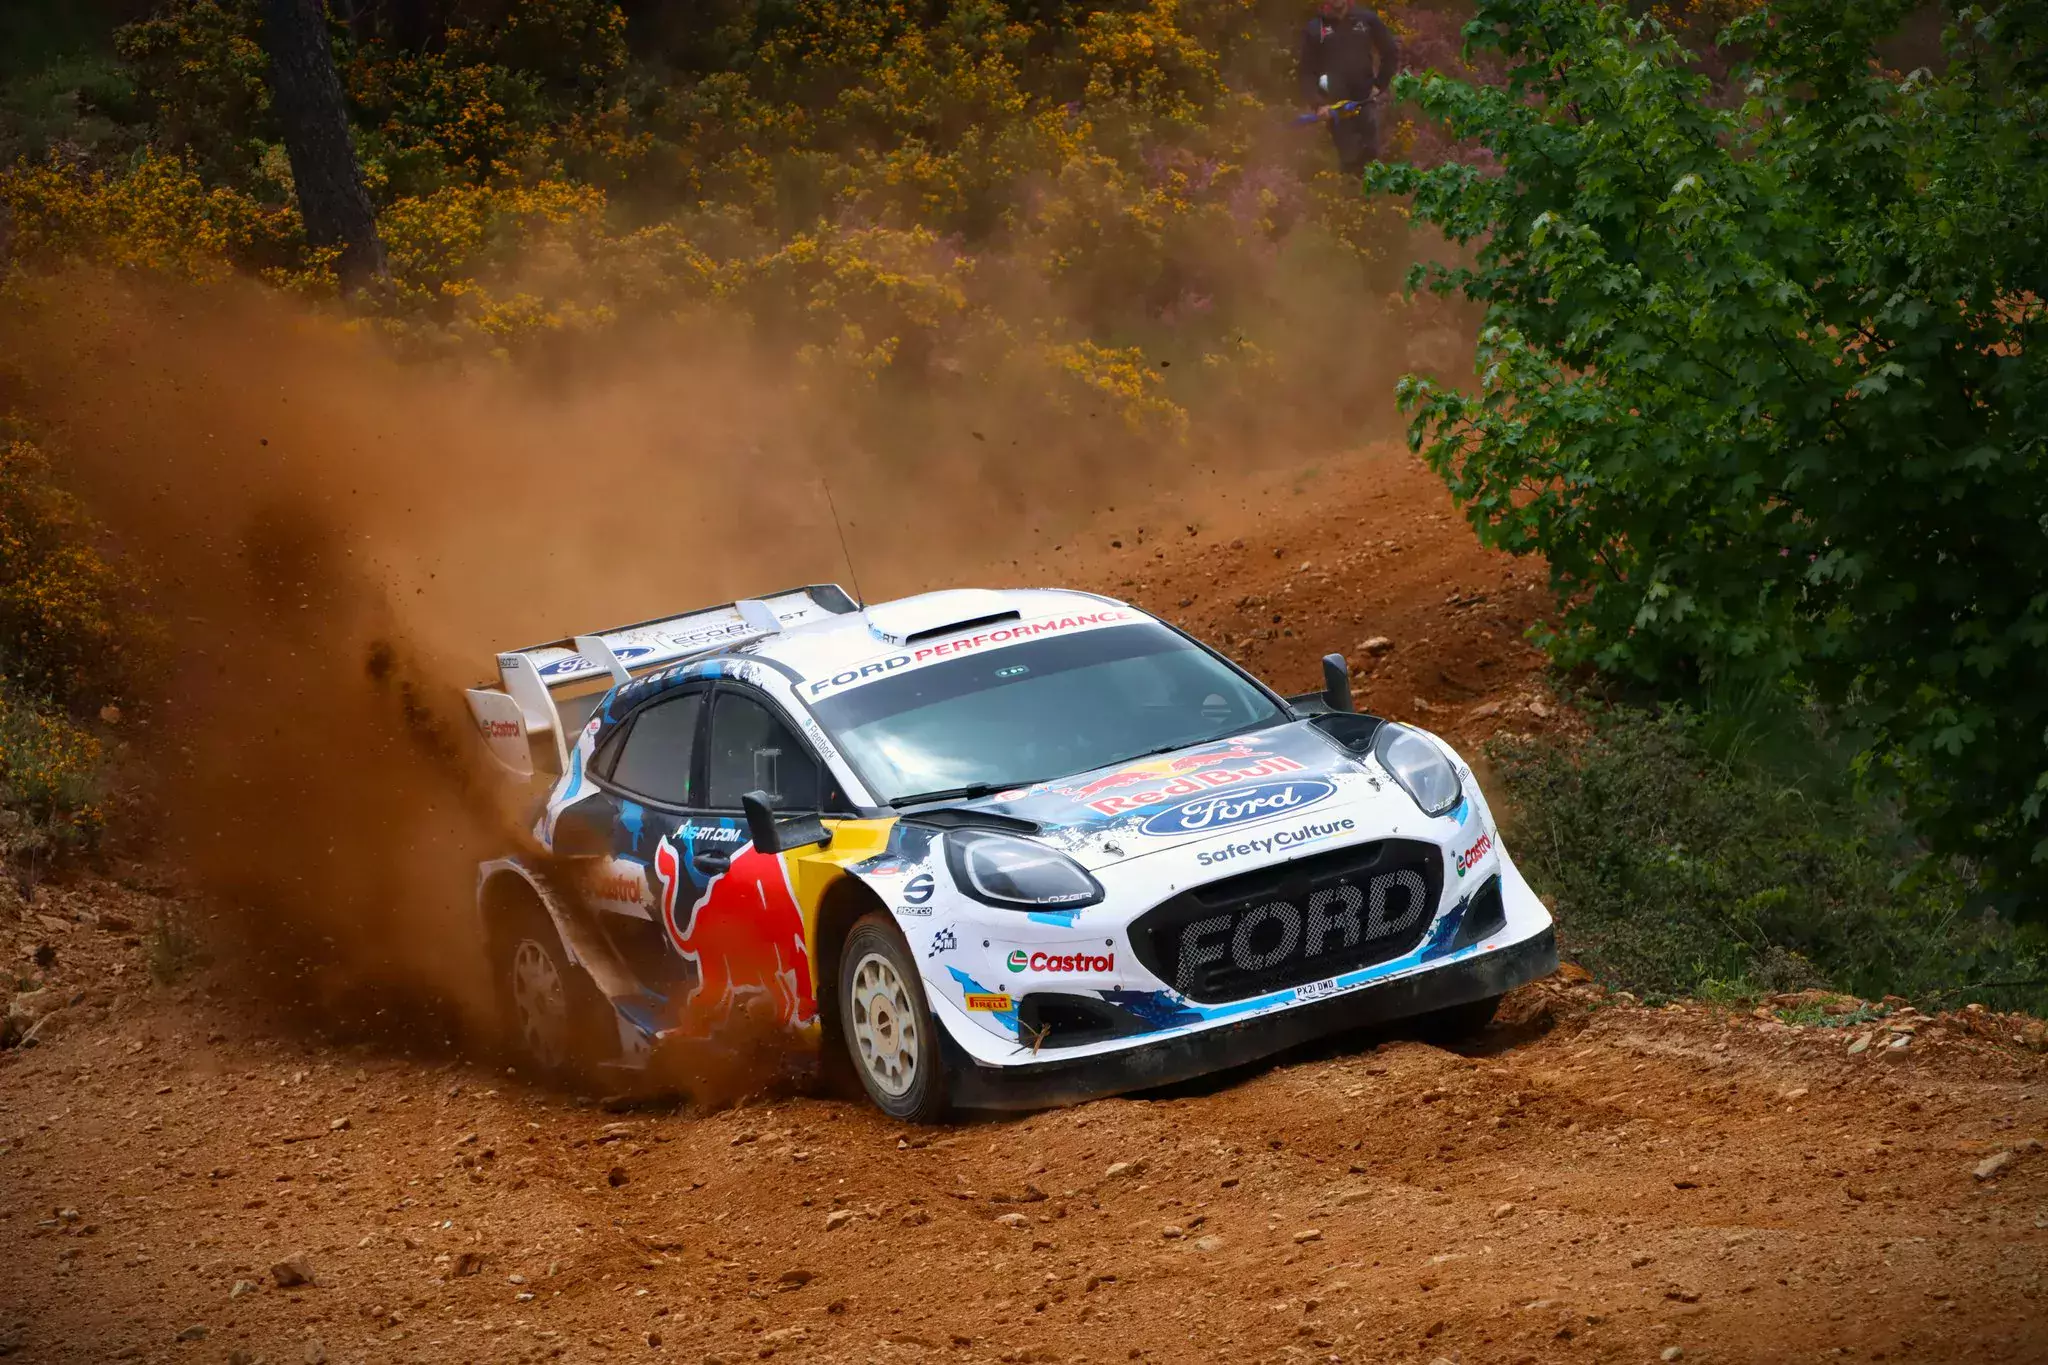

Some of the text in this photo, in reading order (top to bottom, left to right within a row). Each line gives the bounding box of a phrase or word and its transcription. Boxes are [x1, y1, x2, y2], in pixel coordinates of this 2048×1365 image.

[811, 610, 1133, 696] FORD PERFORMANCE
[1089, 755, 1307, 817] Red Bull
[1179, 786, 1303, 830] Ford
[1196, 817, 1355, 867] SafetyCulture
[1464, 830, 1492, 869] Castrol
[897, 906, 933, 916] sparco
[1175, 869, 1428, 990] FORD
[1029, 951, 1115, 973] Castrol
[968, 996, 1009, 1009] PIRELLI
[1296, 984, 1316, 997] PX21
